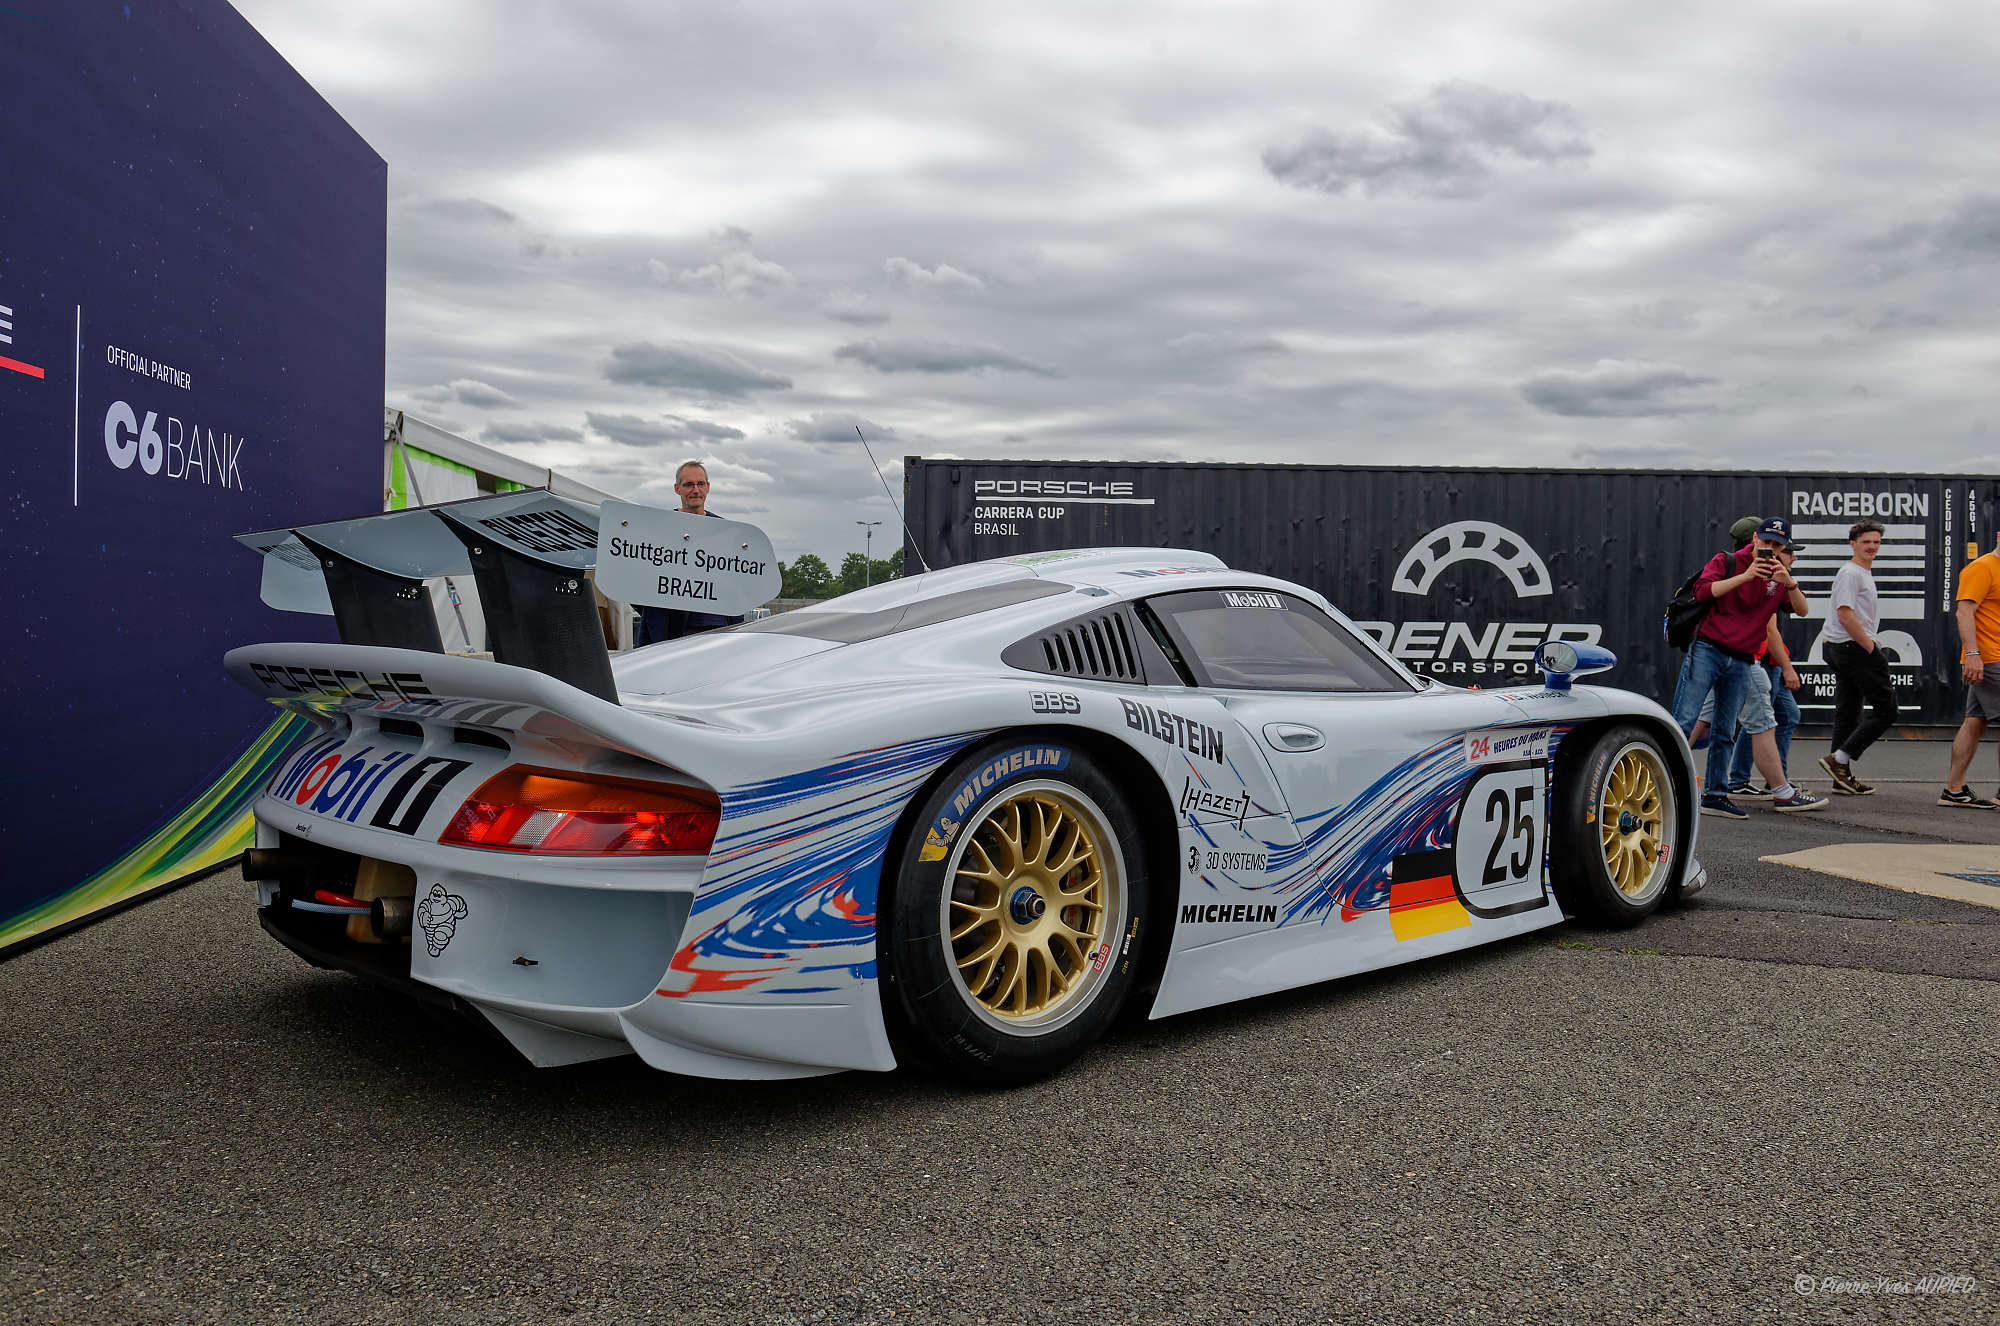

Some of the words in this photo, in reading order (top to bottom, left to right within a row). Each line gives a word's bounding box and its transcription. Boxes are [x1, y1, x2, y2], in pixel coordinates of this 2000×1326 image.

[107, 345, 150, 377] OFFICIAL
[151, 360, 191, 391] PARTNER
[104, 400, 163, 475] C6
[167, 417, 244, 491] BANK
[974, 480, 1133, 495] PORSCHE
[974, 506, 1034, 519] CARRERA
[1038, 507, 1065, 519] CUP
[1792, 491, 1929, 517] RACEBORN
[1944, 488, 1952, 532] CEDU
[1968, 489, 1976, 533] 45G1
[974, 523, 1019, 536] BRASIL
[609, 536, 689, 567] Stuttgart
[694, 548, 766, 576] Sportcar
[657, 575, 719, 601] BRAZIL
[1225, 593, 1268, 608] Mobil
[1264, 594, 1282, 608] 1
[249, 662, 444, 706] PORSCHE
[1799, 673, 1837, 685] YEARS
[1029, 691, 1081, 715] BBS
[1118, 697, 1224, 766] BILSTEIN
[1470, 736, 1490, 761] 24
[1494, 736, 1518, 754] HEURES
[1518, 734, 1528, 746] DU
[273, 738, 416, 823] Mobil
[369, 756, 475, 836] 1
[953, 748, 1061, 817] MICHELIN
[1185, 787, 1243, 814] HAZET
[1481, 785, 1535, 886] 25
[1205, 851, 1219, 870] 3D
[1220, 851, 1267, 871] SYSTEMS
[1180, 904, 1278, 924] MICHELIN
[1093, 944, 1110, 972] BBS
